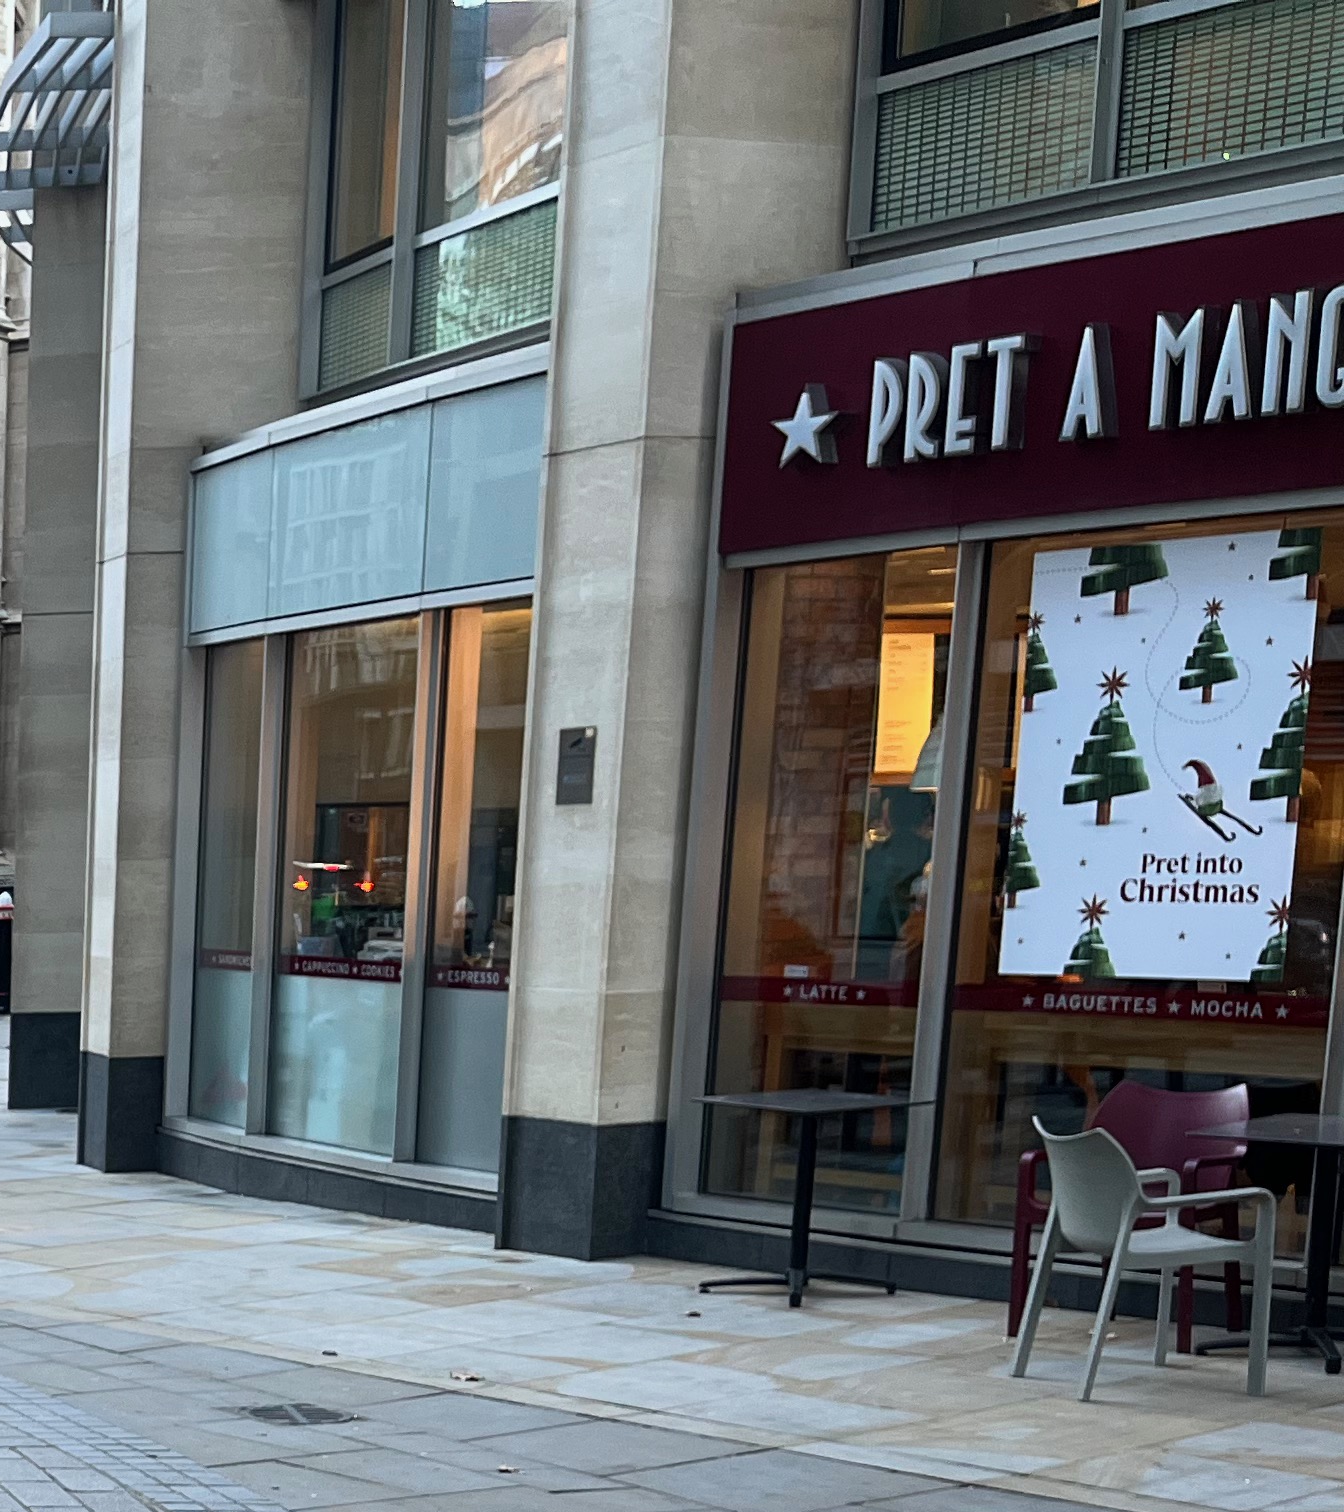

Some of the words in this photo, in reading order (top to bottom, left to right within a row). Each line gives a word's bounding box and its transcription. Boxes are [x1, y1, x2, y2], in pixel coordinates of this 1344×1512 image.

[867, 333, 1034, 468] PRET
[1059, 323, 1112, 442] A
[1148, 284, 1344, 431] MANG
[1141, 852, 1190, 874] Pret
[1195, 851, 1243, 874] into
[1120, 877, 1260, 904] Christmas
[447, 970, 500, 985] ESPRESSO
[799, 984, 848, 1001] LATTE
[1042, 993, 1157, 1014] BAGUETTES
[1191, 1000, 1263, 1019] MOCHA
